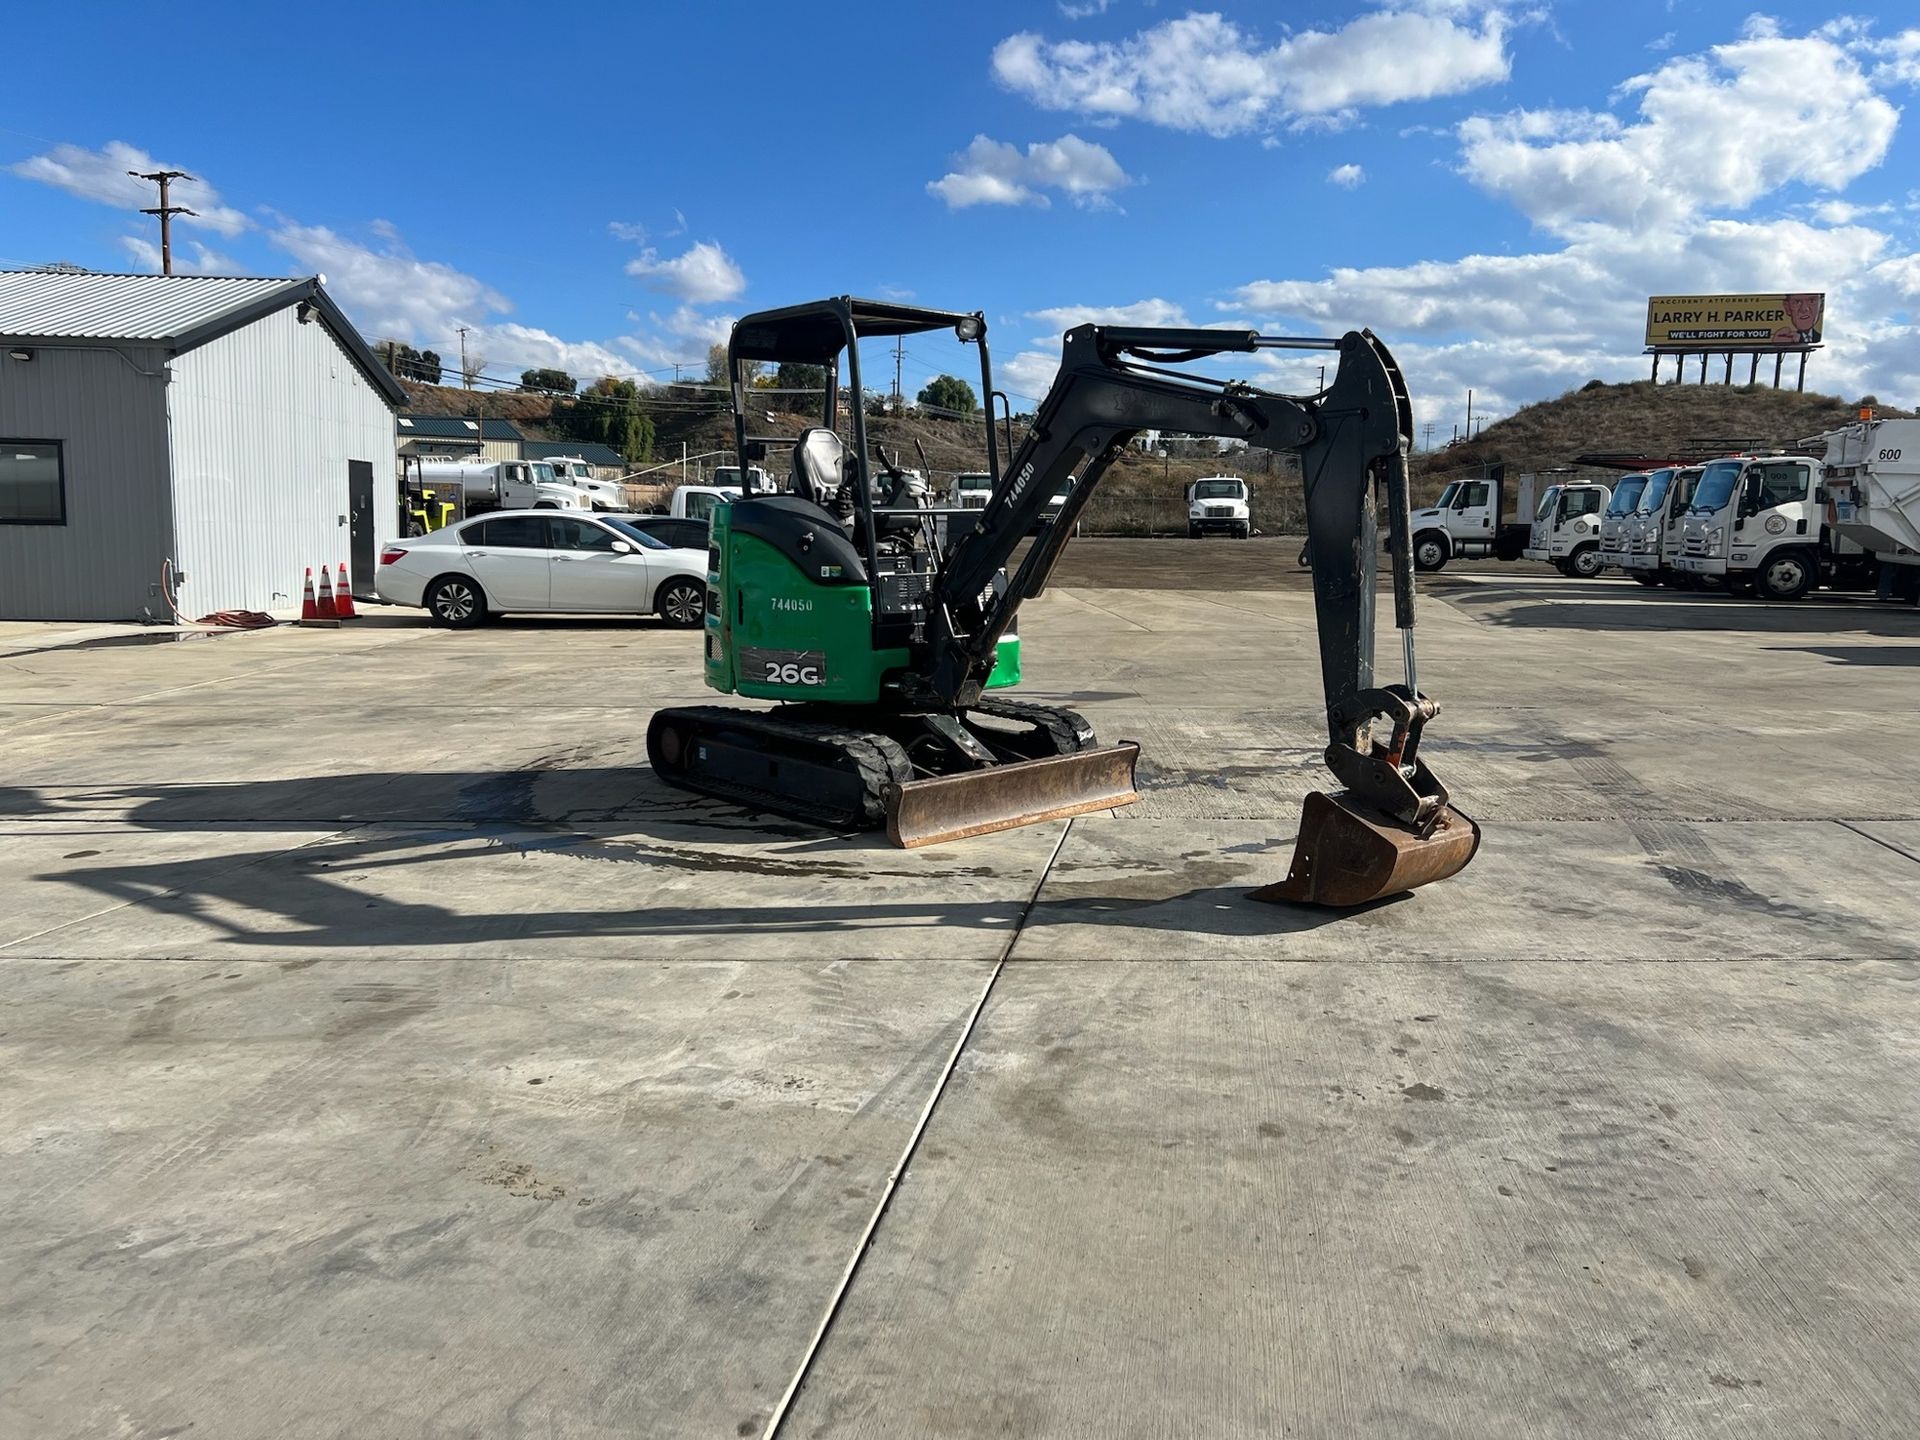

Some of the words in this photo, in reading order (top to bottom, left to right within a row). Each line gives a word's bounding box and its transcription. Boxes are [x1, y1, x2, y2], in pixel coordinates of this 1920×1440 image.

[1653, 311, 1702, 323] LARRY
[1707, 311, 1720, 323] H.
[1724, 310, 1784, 321] PARKER
[1670, 331, 1696, 339] WE'LL
[1727, 330, 1745, 338] FOR
[1747, 330, 1769, 338] YOU!
[1879, 449, 1901, 460] 600
[1004, 462, 1034, 508] 744050
[771, 598, 813, 611] 744050
[765, 661, 819, 685] 26G
